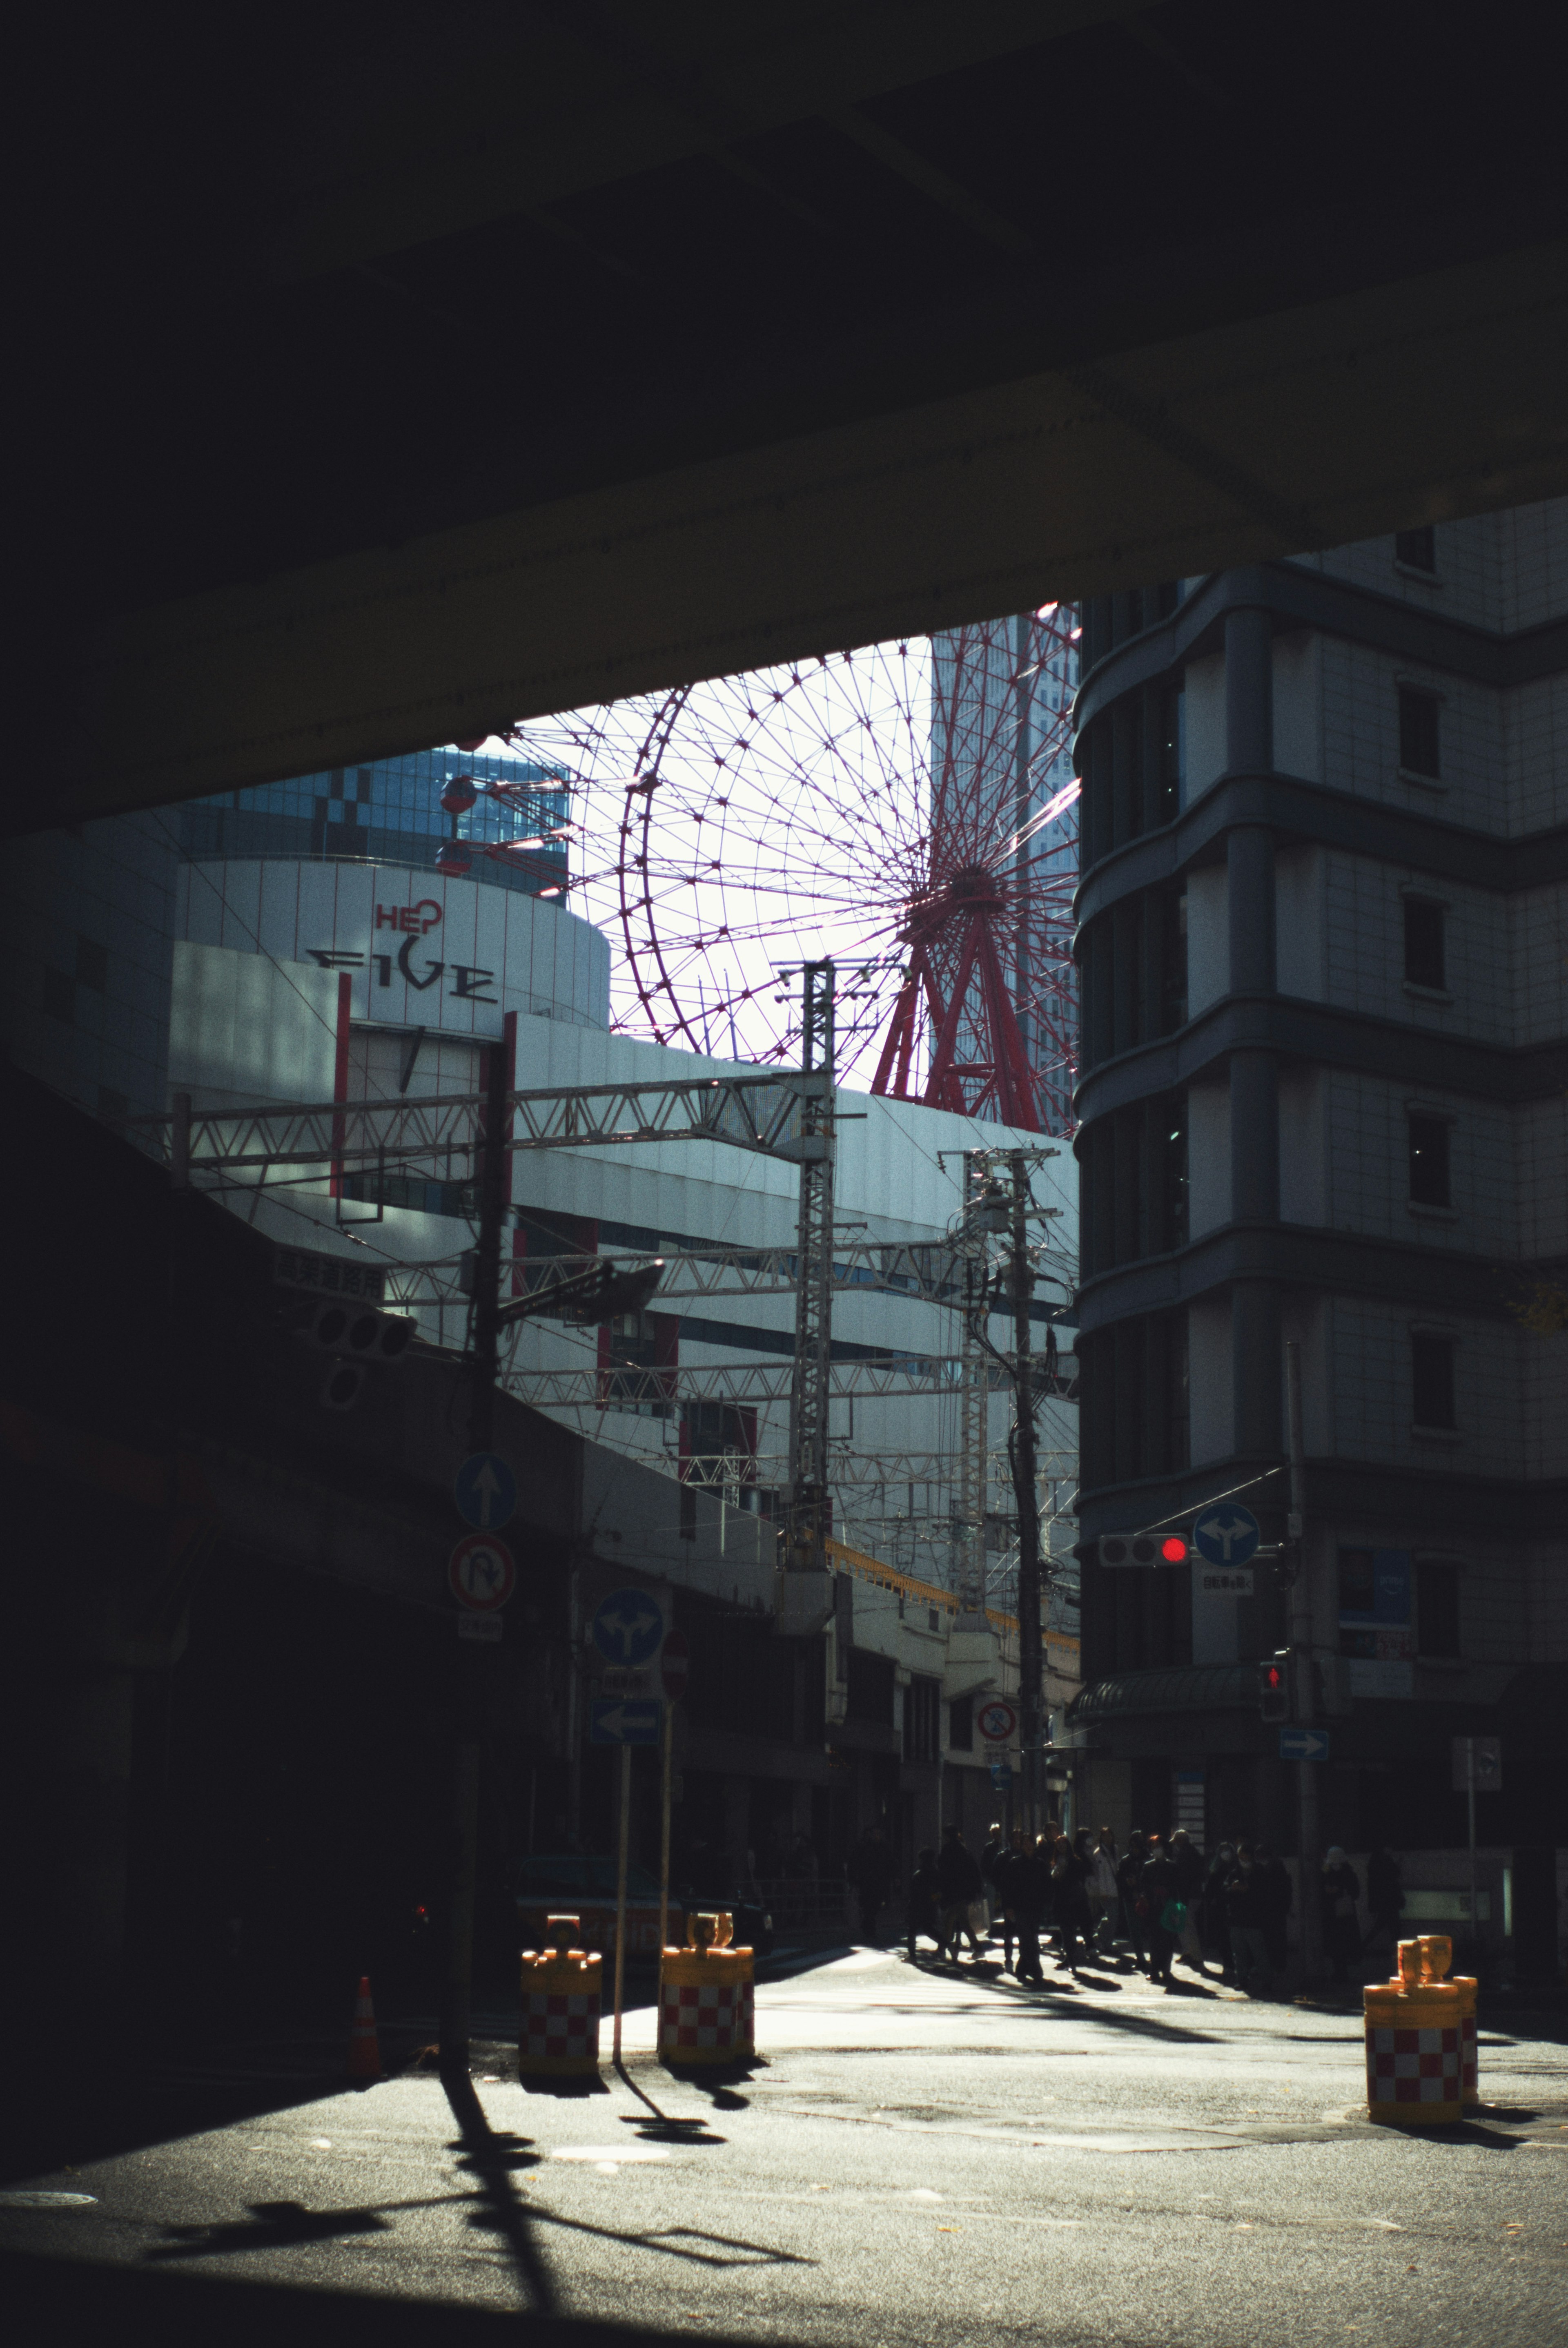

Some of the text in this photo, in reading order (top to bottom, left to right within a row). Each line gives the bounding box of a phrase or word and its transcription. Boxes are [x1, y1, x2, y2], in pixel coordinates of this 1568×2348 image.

[376, 899, 443, 934] HEP
[305, 934, 498, 1003] FIVE
[1379, 1574, 1405, 1587] prime
